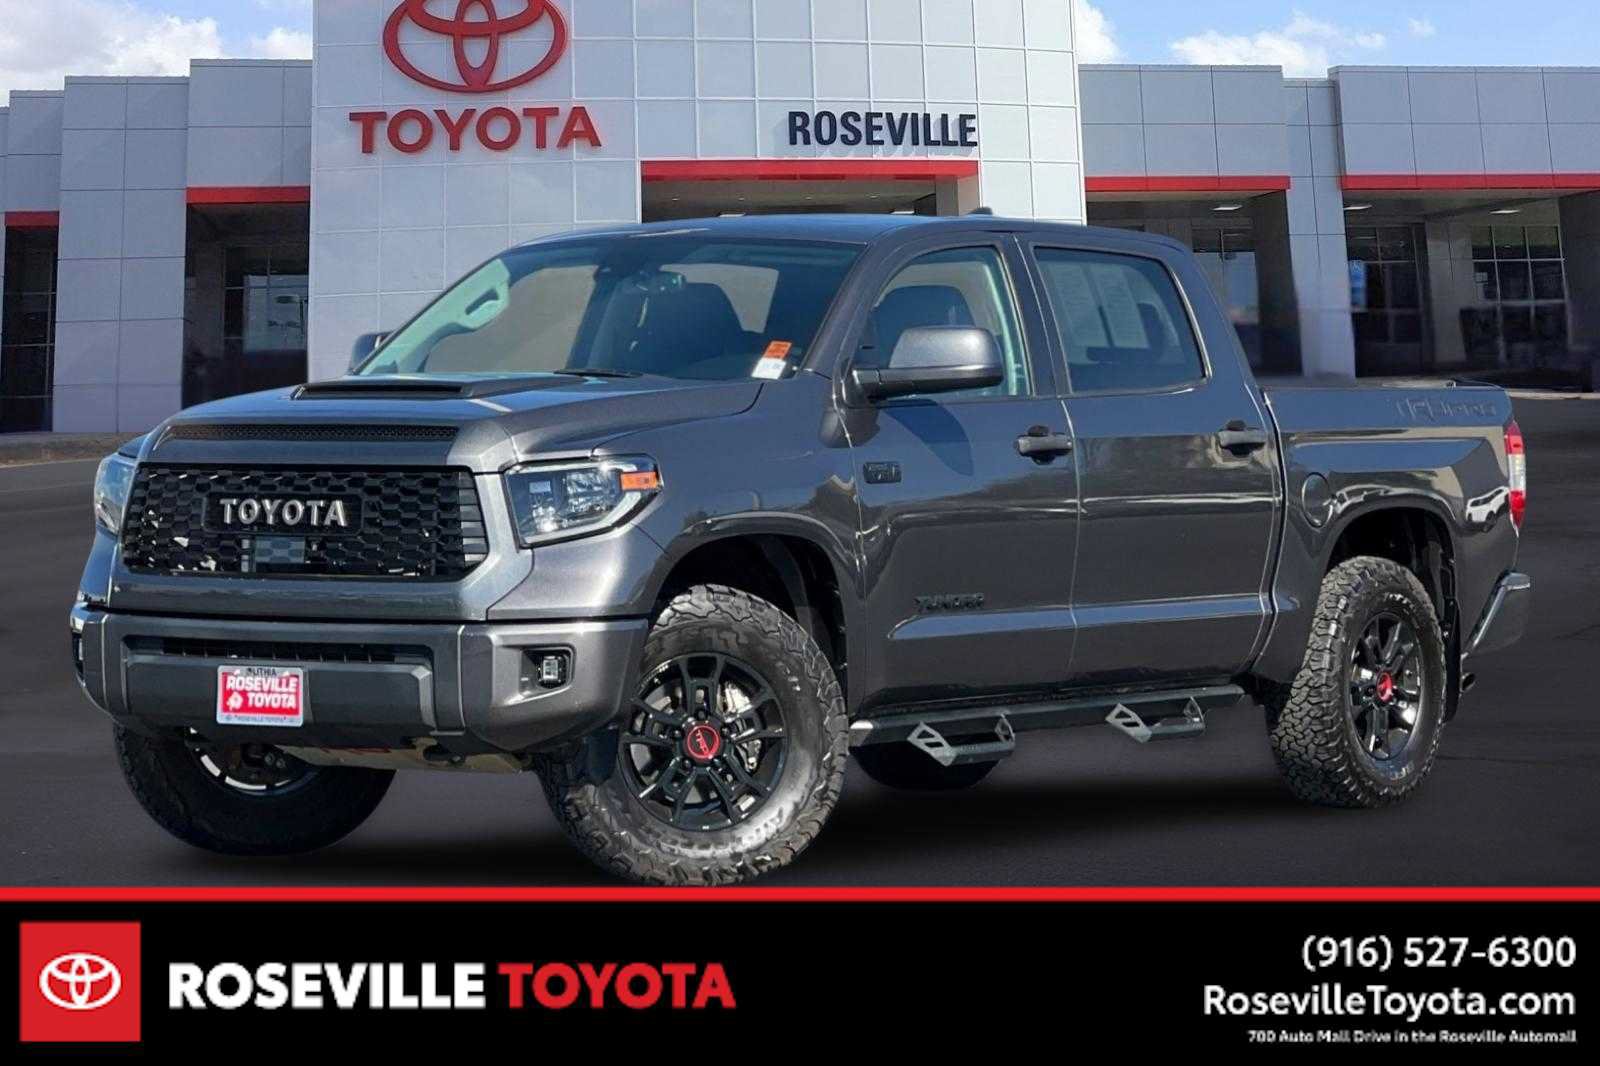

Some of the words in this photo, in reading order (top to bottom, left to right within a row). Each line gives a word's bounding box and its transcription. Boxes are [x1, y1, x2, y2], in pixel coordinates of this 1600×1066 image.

[348, 106, 602, 154] TOYOTA
[787, 110, 978, 147] ROSEVILLE
[219, 498, 348, 527] TOYOTA
[225, 675, 298, 692] ROSEVILLE
[246, 691, 297, 709] TOYOTA
